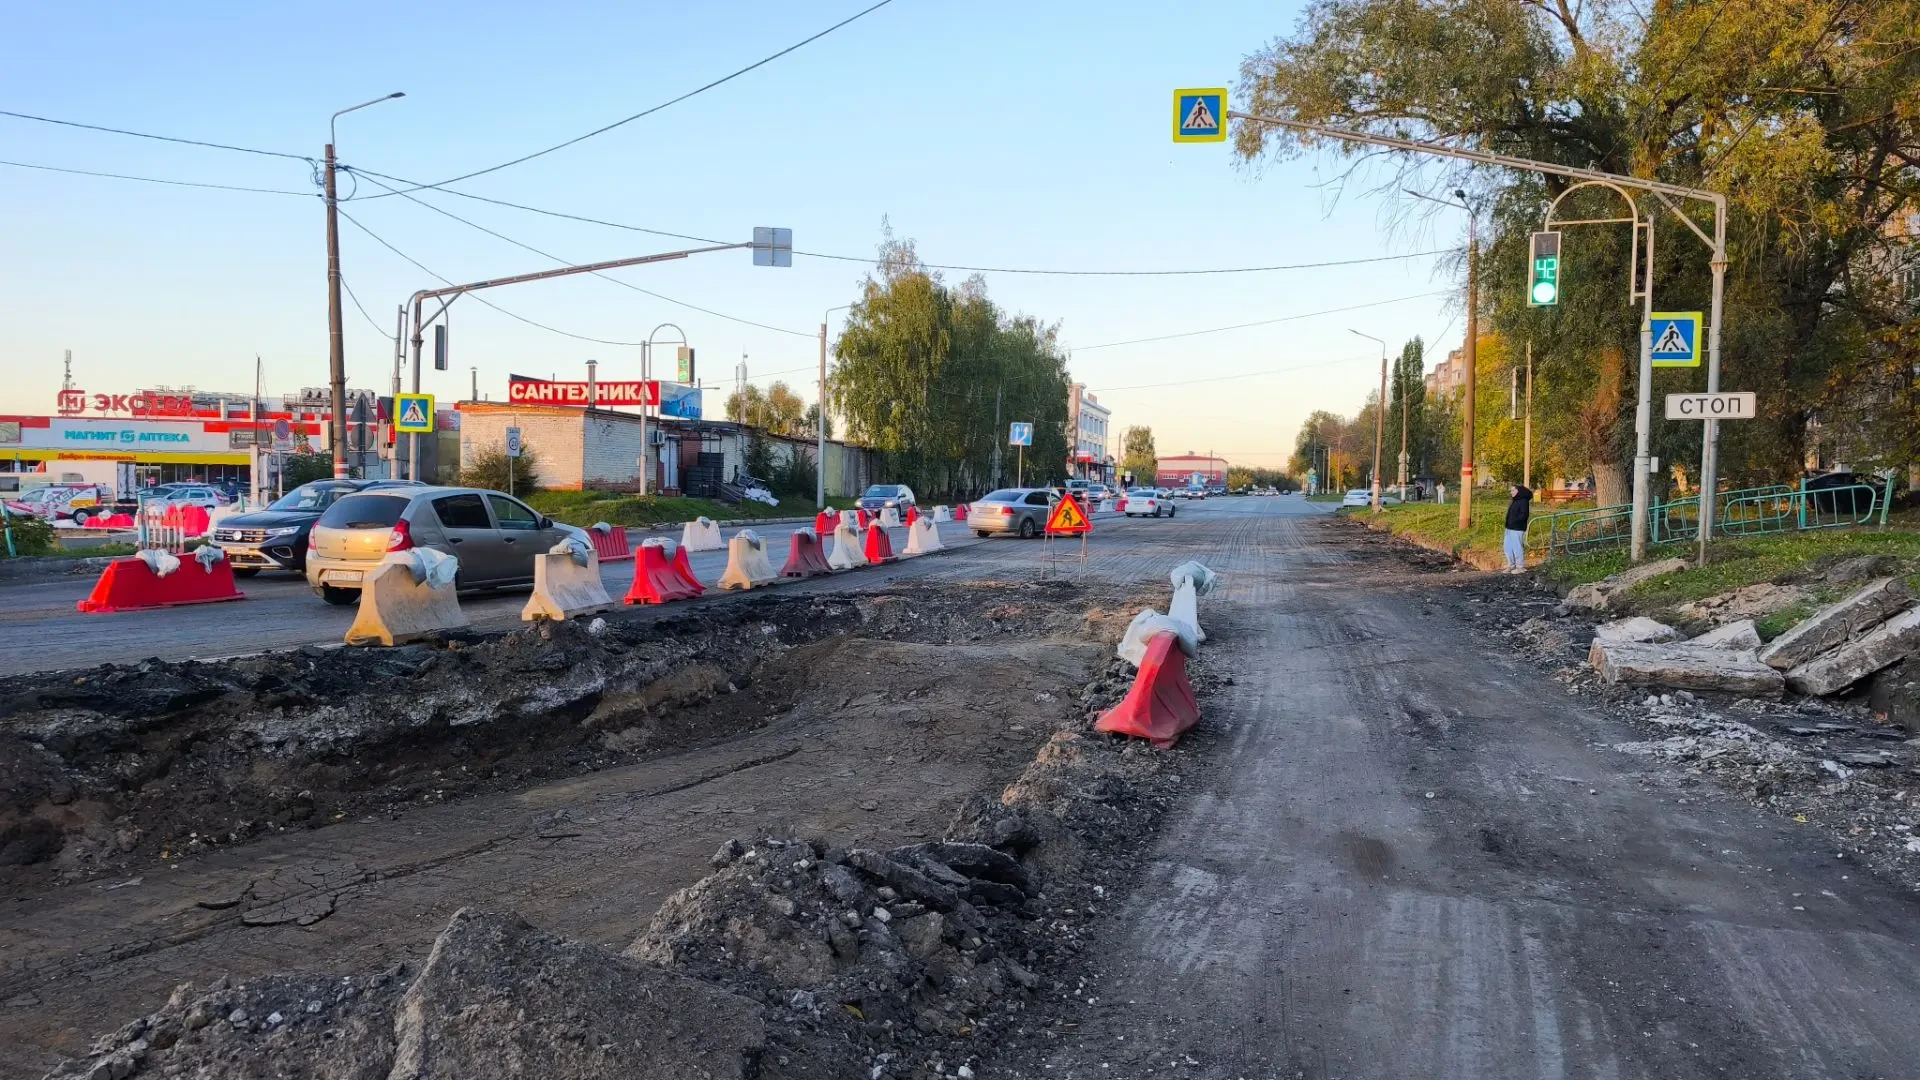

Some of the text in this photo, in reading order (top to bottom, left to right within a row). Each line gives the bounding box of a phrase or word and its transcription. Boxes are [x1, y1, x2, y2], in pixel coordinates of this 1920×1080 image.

[1536, 258, 1557, 279] 42
[510, 383, 653, 400] САНТЕХНИКА
[93, 394, 193, 414] ЭКСТРА
[1679, 397, 1741, 414] СТОП
[64, 430, 190, 443] МАГНИТ АПТЕКА
